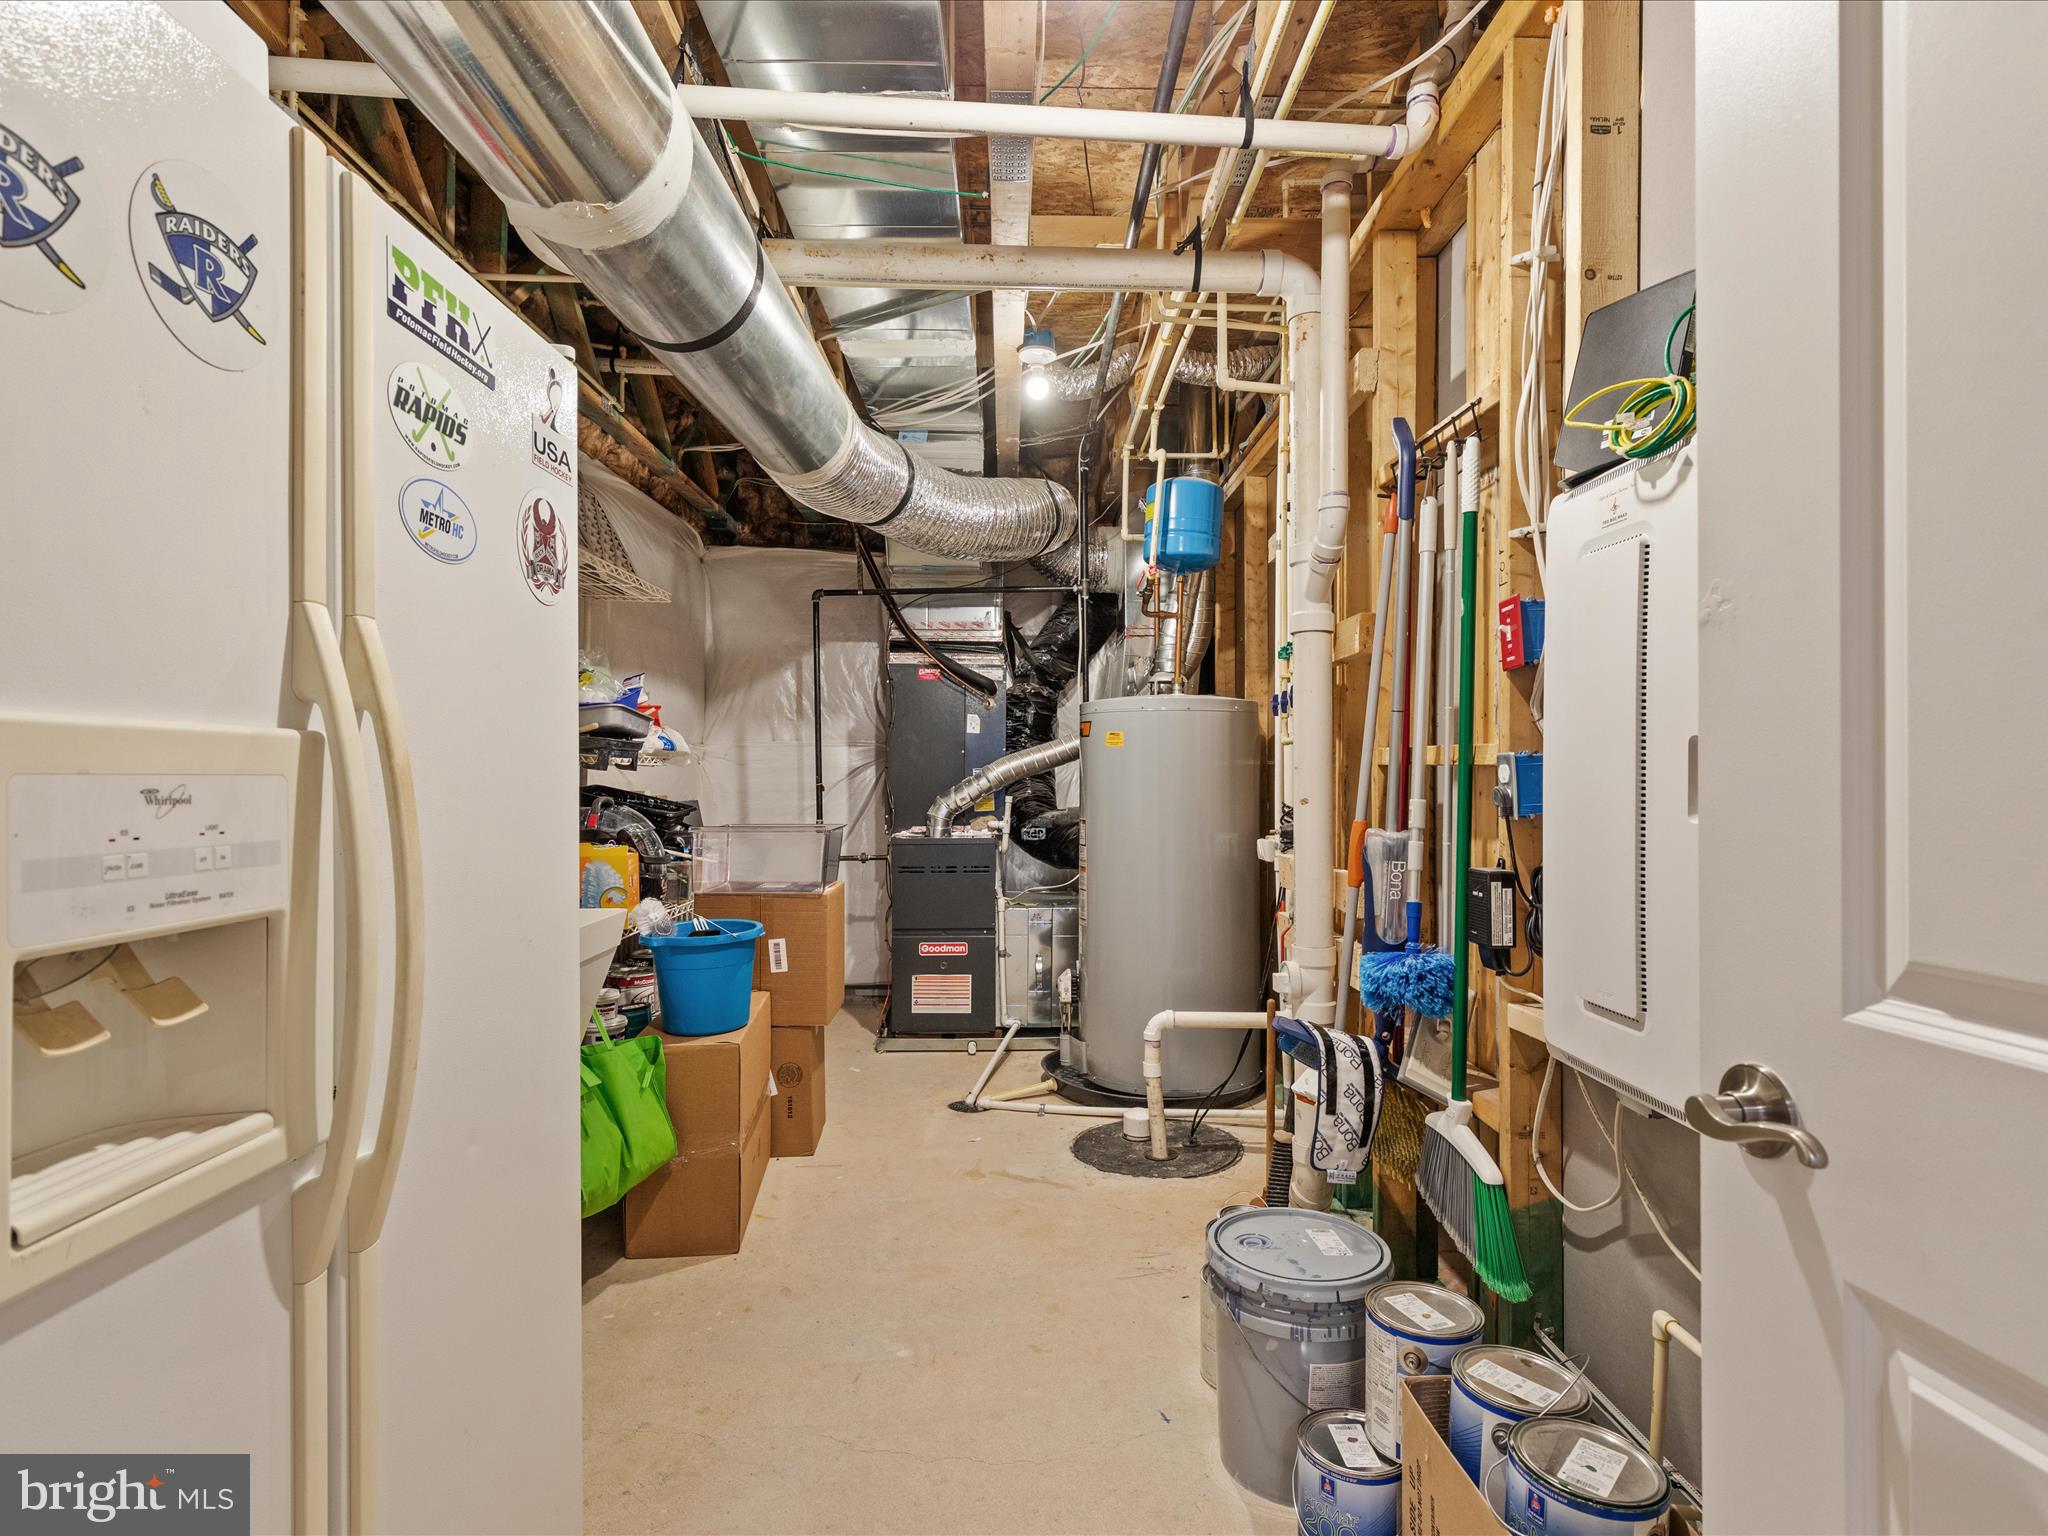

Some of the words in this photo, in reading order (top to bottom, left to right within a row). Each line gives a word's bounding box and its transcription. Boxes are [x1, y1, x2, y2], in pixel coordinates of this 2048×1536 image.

[165, 216, 251, 278] RAIDERS
[192, 244, 232, 304] R
[392, 384, 469, 447] RAPIDS
[533, 430, 572, 474] USA
[533, 453, 550, 470] FIELD
[550, 464, 572, 483] HOCKEY
[419, 508, 452, 535] METRO
[451, 522, 464, 540] HC
[536, 563, 555, 578] DRAMA
[144, 794, 192, 808] Whirlpool
[1389, 861, 1406, 900] Bona
[921, 944, 966, 953] Goodman
[1314, 1135, 1330, 1162] Bo
[1333, 1112, 1360, 1153] Bona
[1409, 1464, 1416, 1490] UP
